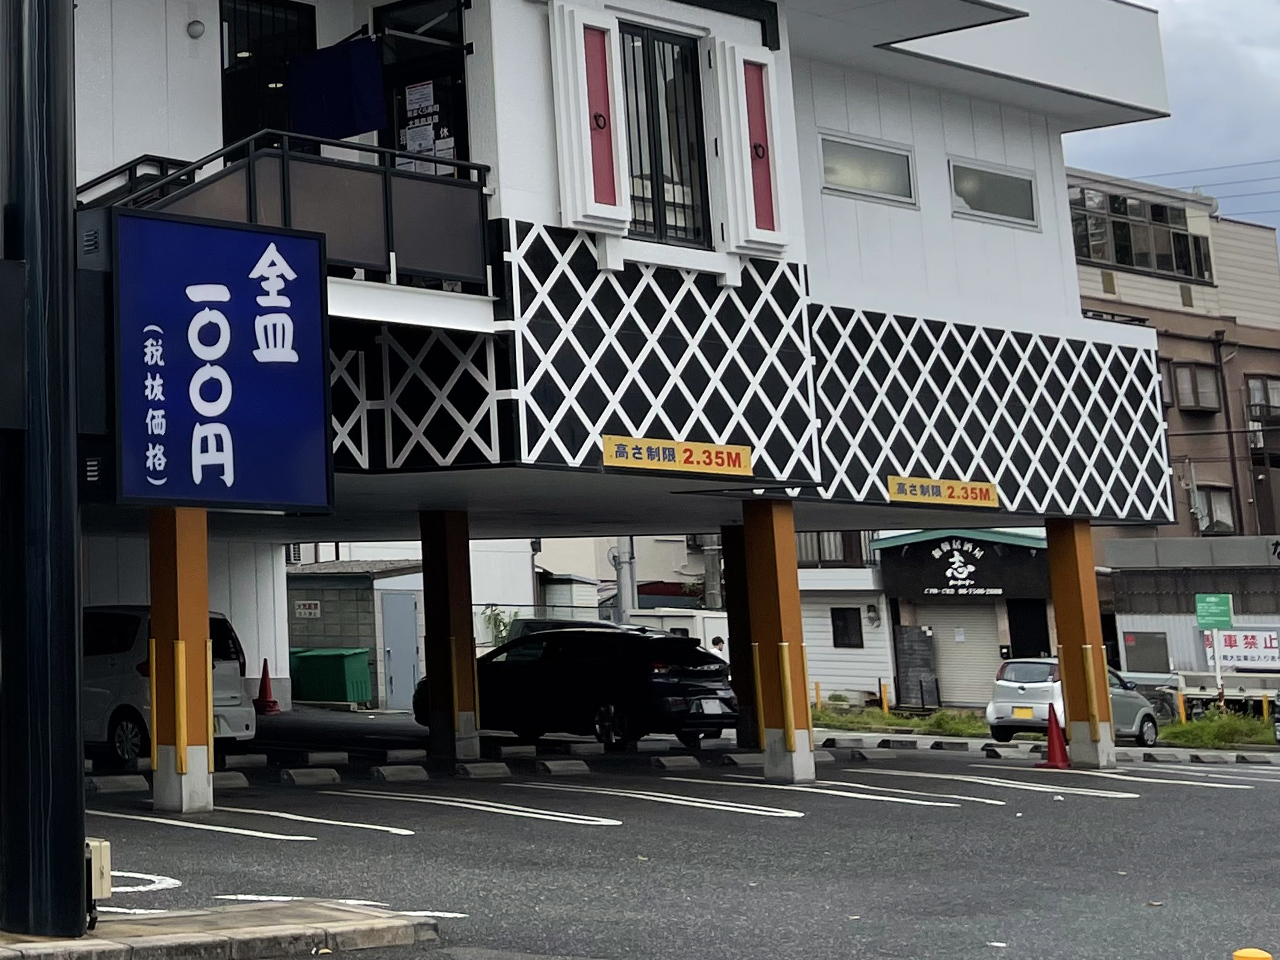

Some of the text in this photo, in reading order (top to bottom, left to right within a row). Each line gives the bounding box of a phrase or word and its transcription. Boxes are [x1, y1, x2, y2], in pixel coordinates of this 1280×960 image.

[248, 242, 299, 363] 全皿
[614, 443, 742, 468] 高さ制限 2.35M
[896, 482, 991, 501] 高さ制限 2.35M
